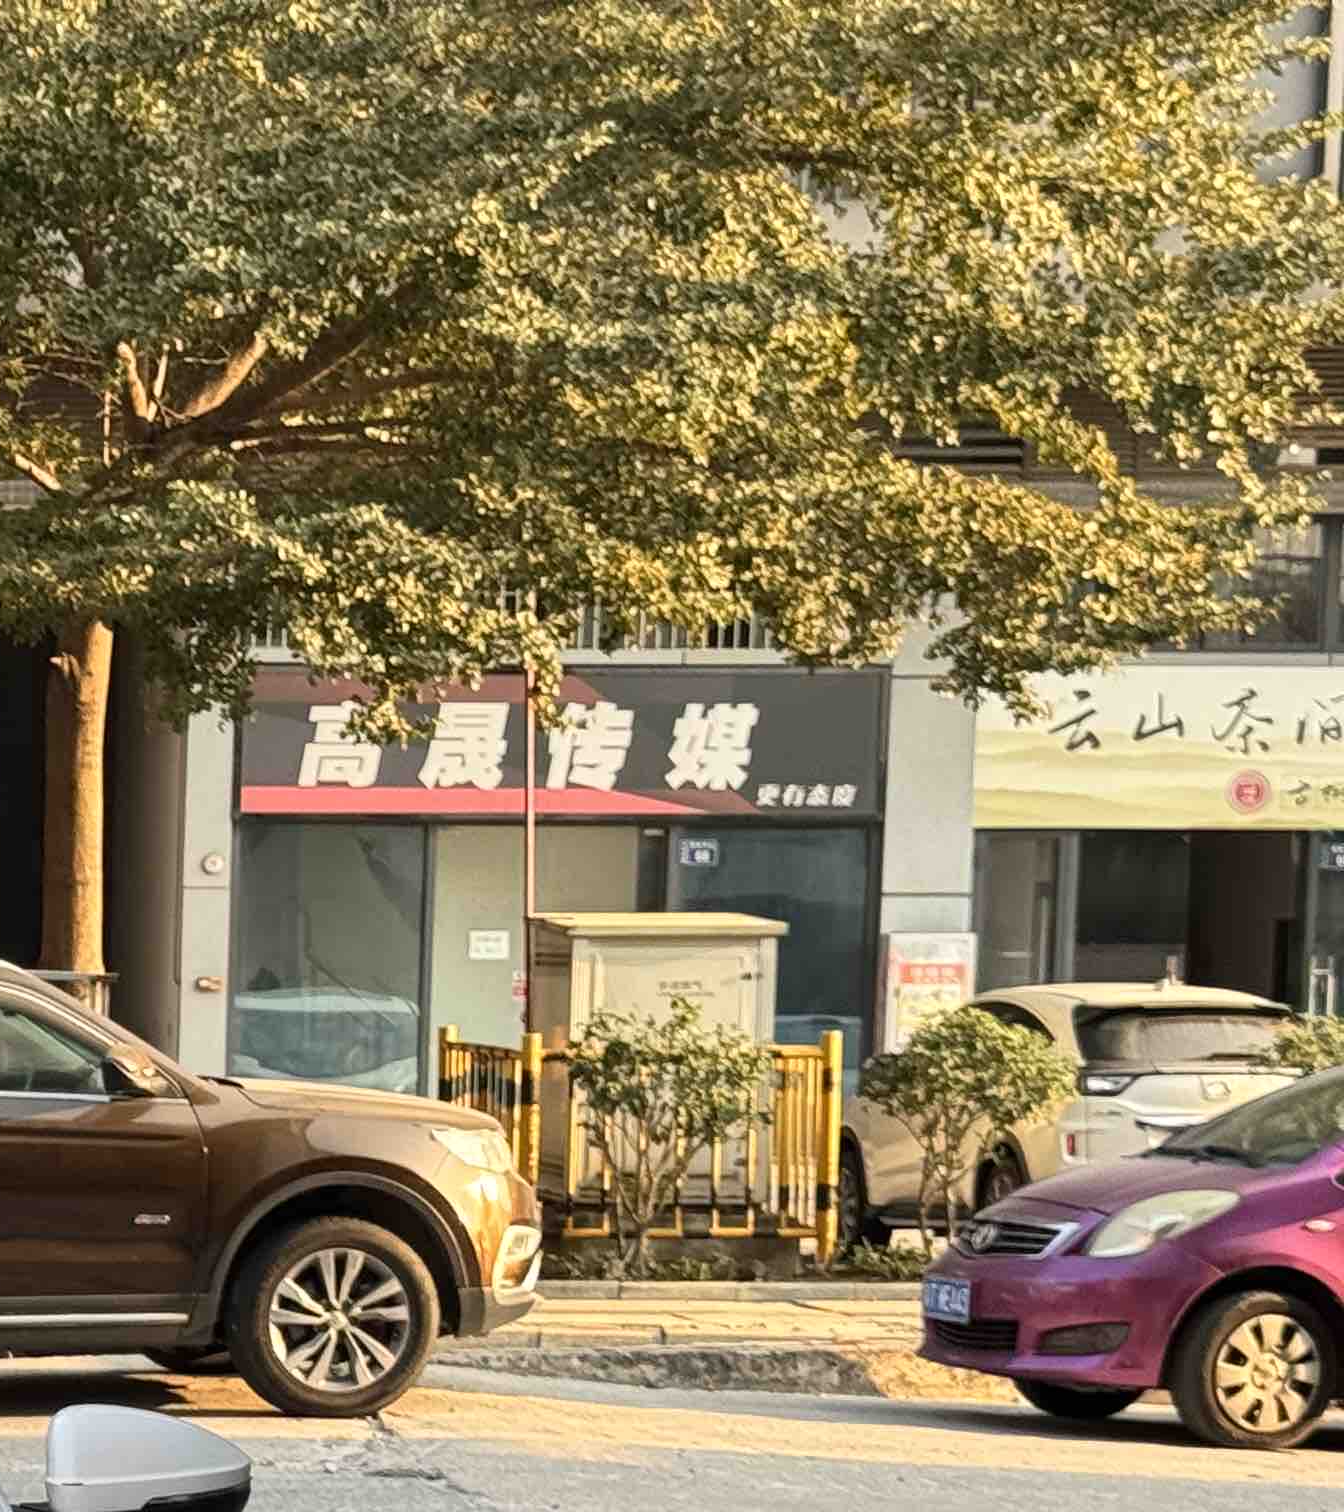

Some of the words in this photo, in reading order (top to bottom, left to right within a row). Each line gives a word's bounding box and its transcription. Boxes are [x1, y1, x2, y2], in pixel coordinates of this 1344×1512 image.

[297, 699, 760, 790] 高晟传媒
[756, 783, 859, 808] 更有态度
